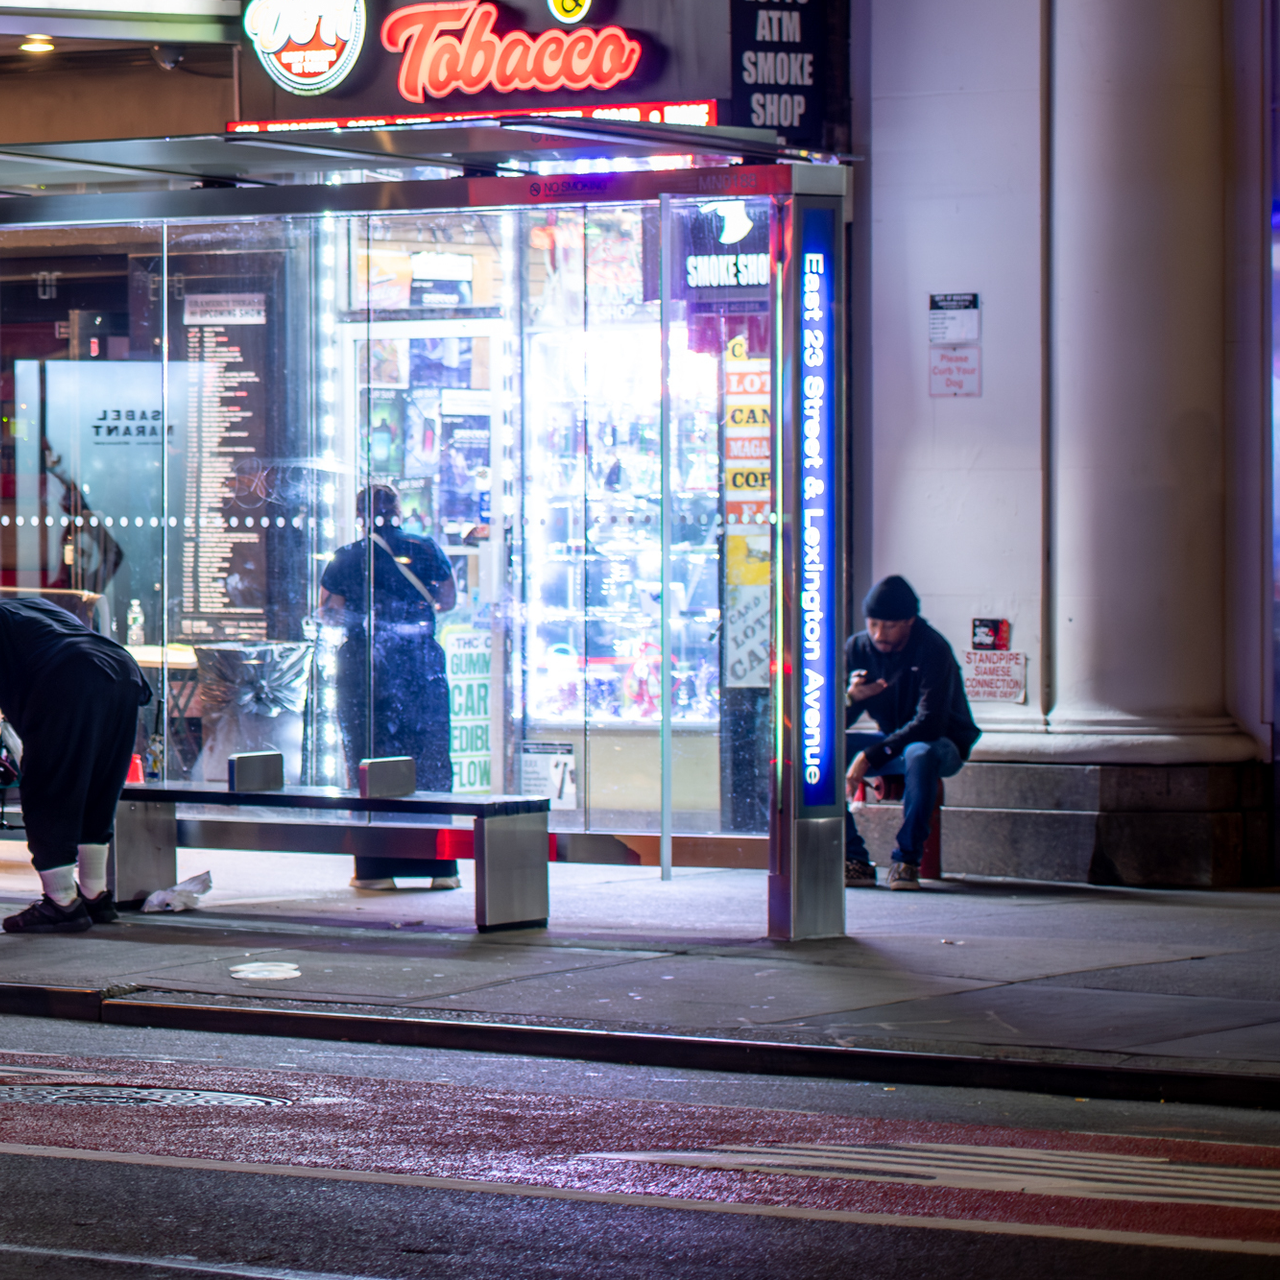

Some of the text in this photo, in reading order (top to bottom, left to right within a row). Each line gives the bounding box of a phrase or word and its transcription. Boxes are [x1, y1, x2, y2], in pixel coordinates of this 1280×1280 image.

[756, 10, 801, 43] ATM
[743, 51, 813, 87] SMOKE
[751, 93, 806, 127] SHOP
[544, 181, 607, 193] NO SMOKING
[686, 255, 770, 288] SMOKE SHO
[941, 354, 968, 362] Please
[933, 366, 976, 375] Curb Your
[730, 375, 770, 393] LOT
[946, 379, 963, 389] Dog
[730, 409, 771, 426] CAN
[729, 441, 769, 458] MAGA
[732, 472, 771, 489] COP
[802, 253, 824, 785] East 23 Street & Lexington Avenue
[732, 614, 771, 650] LOT
[456, 637, 479, 649] THC
[451, 653, 491, 675] GUMM
[730, 639, 771, 682] CAN
[966, 652, 1021, 665] STANDPIPE
[975, 666, 1012, 677] SIAMESE
[965, 678, 1022, 689] CONNECTION
[450, 684, 489, 717] CAR
[967, 690, 981, 698] FOR
[983, 690, 998, 698] FIRE
[450, 725, 491, 754] EDIBL
[451, 761, 491, 788] FLOW
